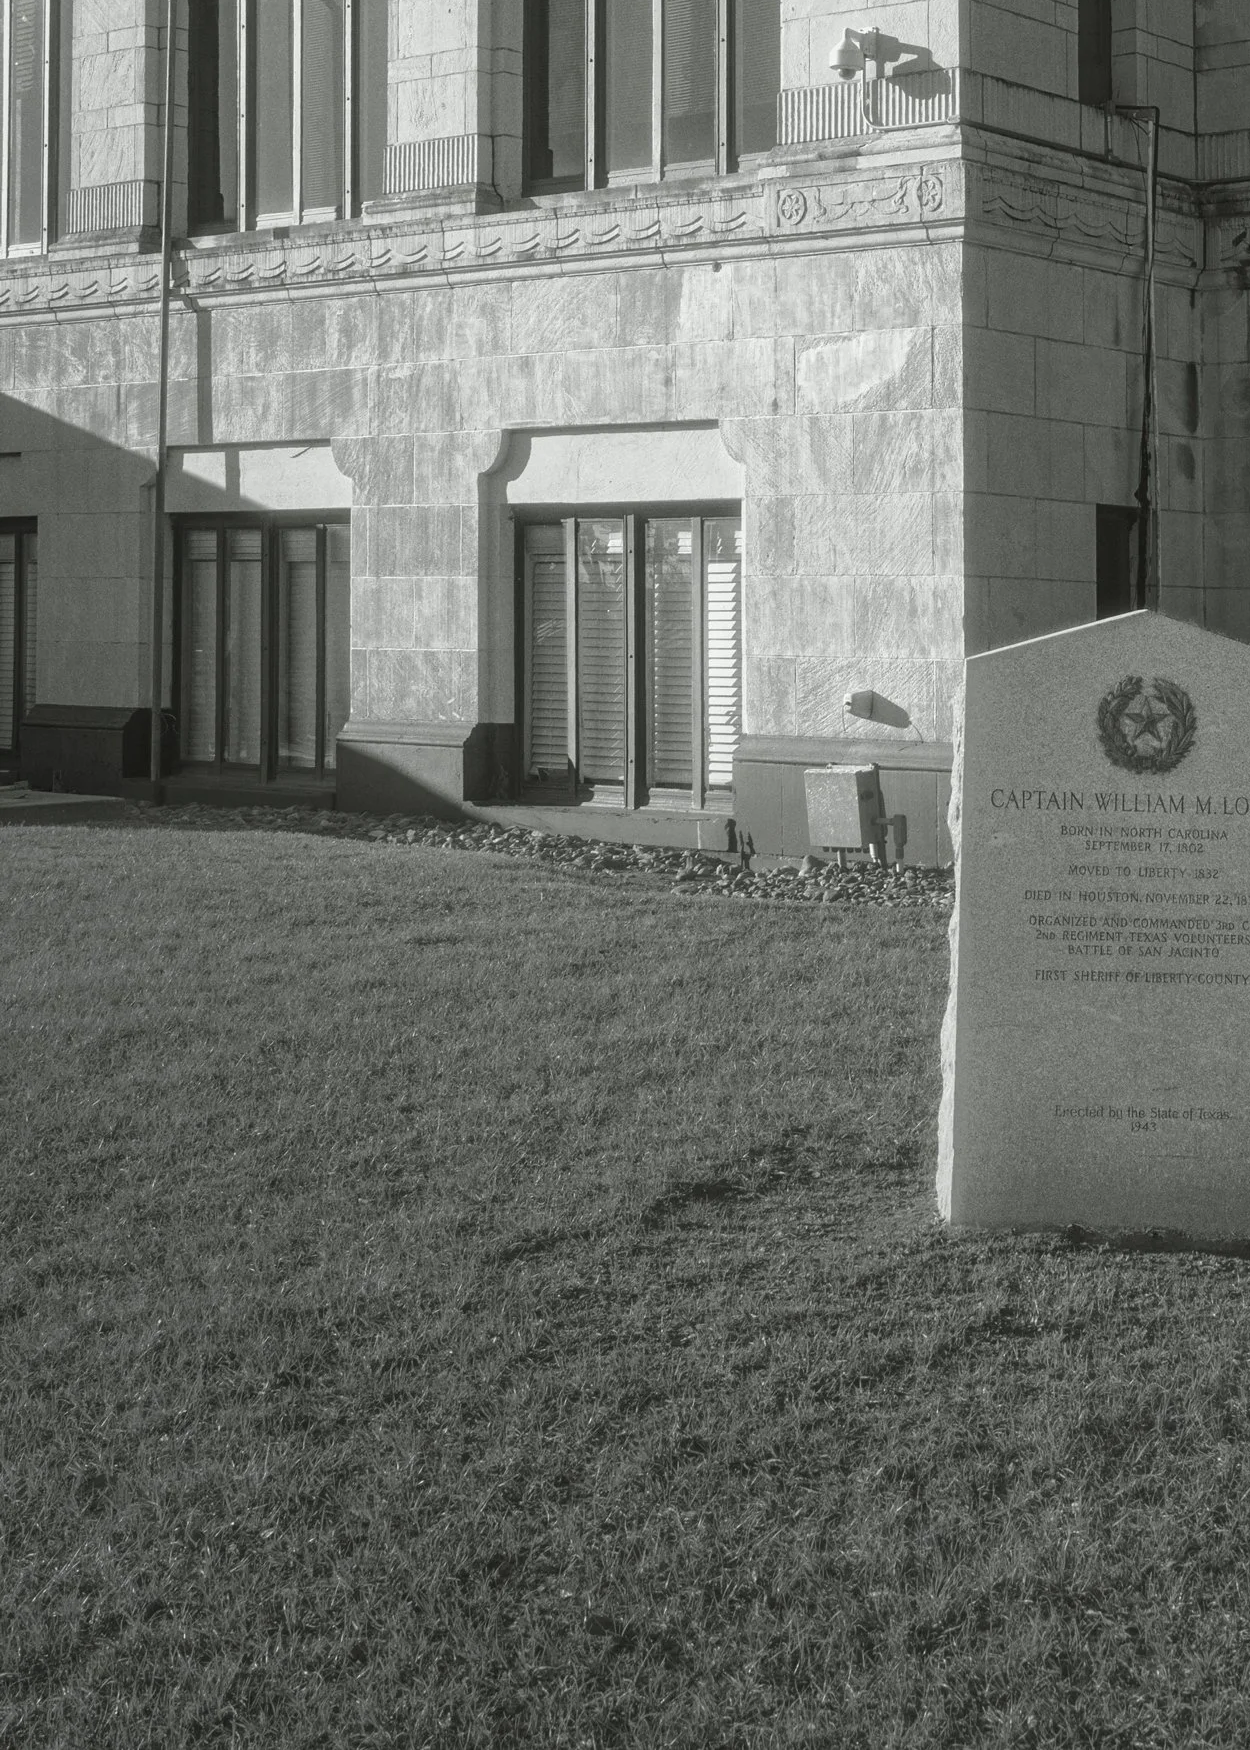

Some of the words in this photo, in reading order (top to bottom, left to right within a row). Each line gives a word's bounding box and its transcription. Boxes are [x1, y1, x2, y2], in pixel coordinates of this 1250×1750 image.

[990, 788, 1085, 810] CAPTAIN
[1095, 792, 1185, 814] WILLIAM
[1195, 795, 1217, 815] M.
[1060, 825, 1094, 837] BORN
[1099, 826, 1113, 837] IN
[1121, 827, 1162, 839] NORTH
[1168, 828, 1228, 840] CAROLINA
[1085, 840, 1152, 852] SEPTEMBER
[1159, 842, 1172, 854] 17,
[1177, 842, 1205, 854] 1802
[1068, 864, 1110, 877] MOVED
[1115, 866, 1131, 877] TO
[1138, 867, 1187, 879] LIBERTY
[1194, 868, 1219, 879] 1832
[1024, 889, 1052, 901] DIED
[1059, 890, 1072, 901] IN
[1145, 893, 1210, 905] NOVEMBER
[1215, 894, 1233, 906] 22,
[1028, 914, 1097, 927] ORGANIZED
[1102, 917, 1128, 928] AND
[1132, 918, 1211, 930] COMMANDED
[1215, 920, 1235, 931] 3RD
[1036, 929, 1056, 940] 2ND
[1062, 930, 1123, 942] REGIMENT
[1129, 932, 1168, 943] TEXAS
[1174, 933, 1250, 946] VOLUNTEERS
[1067, 944, 1113, 956] BATTLE
[1118, 945, 1133, 956] OF
[1138, 946, 1163, 957] SAN
[1168, 947, 1220, 958] JACINTO
[1035, 969, 1068, 981] FIRST
[1073, 970, 1121, 982] SHERIFF
[1125, 971, 1141, 983] OF
[1145, 972, 1193, 984] LIBERTY
[1197, 973, 1250, 985] COUNTY
[1054, 1105, 1104, 1118] Erected
[1109, 1105, 1123, 1120] by
[1127, 1106, 1146, 1119] the
[1150, 1106, 1179, 1119] State
[1182, 1107, 1194, 1121] of
